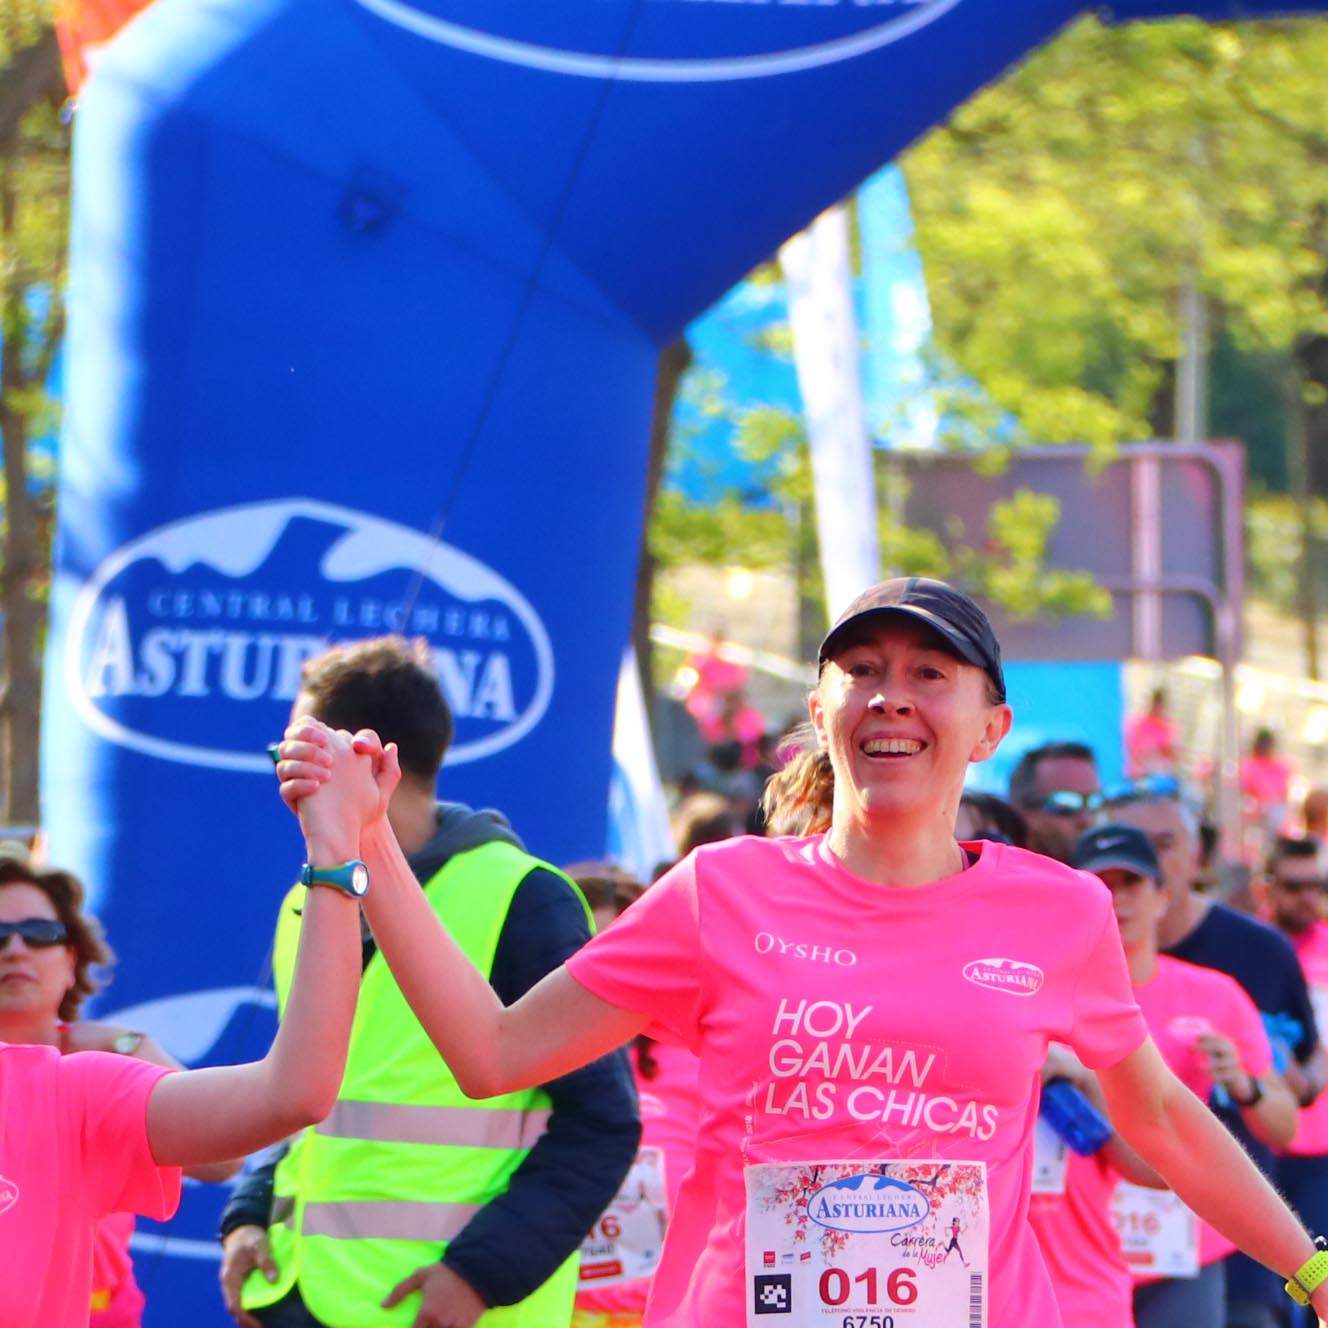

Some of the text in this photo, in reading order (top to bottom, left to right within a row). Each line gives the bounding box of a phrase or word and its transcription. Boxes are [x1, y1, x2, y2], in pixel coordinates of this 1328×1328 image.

[147, 590, 512, 640] CENTRAL LECHERA
[755, 931, 858, 967] OYSHO
[773, 997, 873, 1040] HOY
[768, 1038, 936, 1088] GANAN
[765, 1081, 1000, 1141] LAS CHICAS
[816, 1196, 921, 1218] ASTURIANA
[890, 1232, 937, 1248] Carrera
[919, 1249, 949, 1270] Mujer
[818, 1267, 919, 1306] 016
